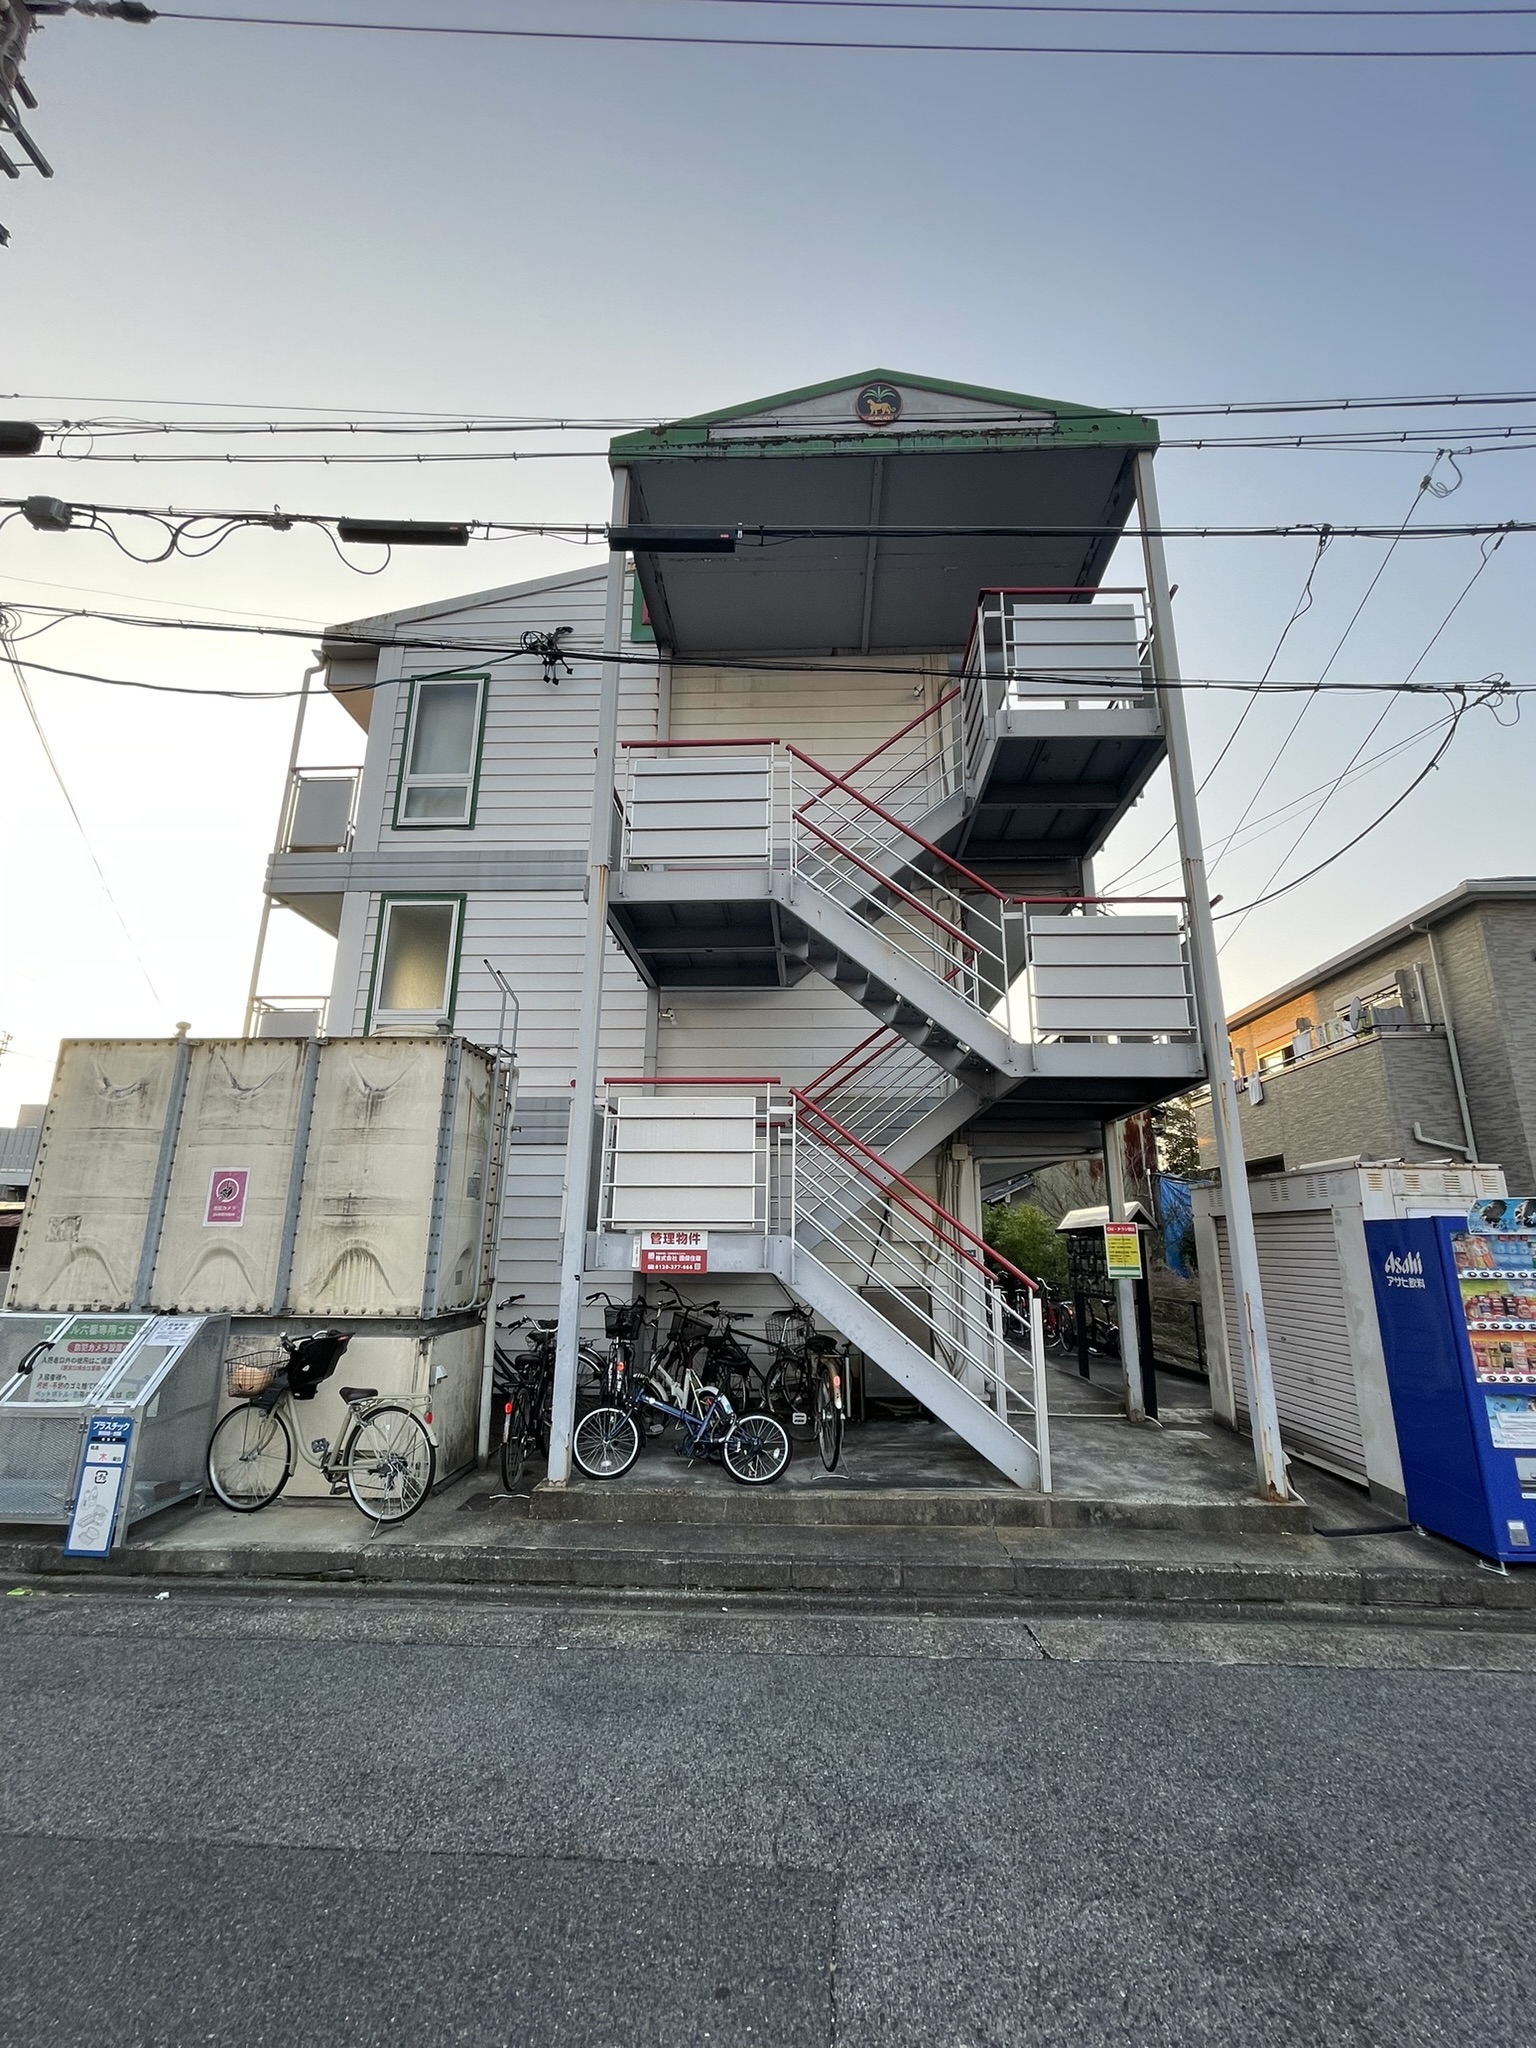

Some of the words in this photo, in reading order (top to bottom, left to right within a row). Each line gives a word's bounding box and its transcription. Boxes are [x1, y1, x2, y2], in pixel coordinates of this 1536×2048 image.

[650, 1231, 701, 1245] 管理物件
[1384, 1250, 1423, 1275] Asahi
[1386, 1275, 1426, 1289] アサヒ飲料
[93, 1421, 130, 1431] プラスチック
[99, 1453, 108, 1462] 木
